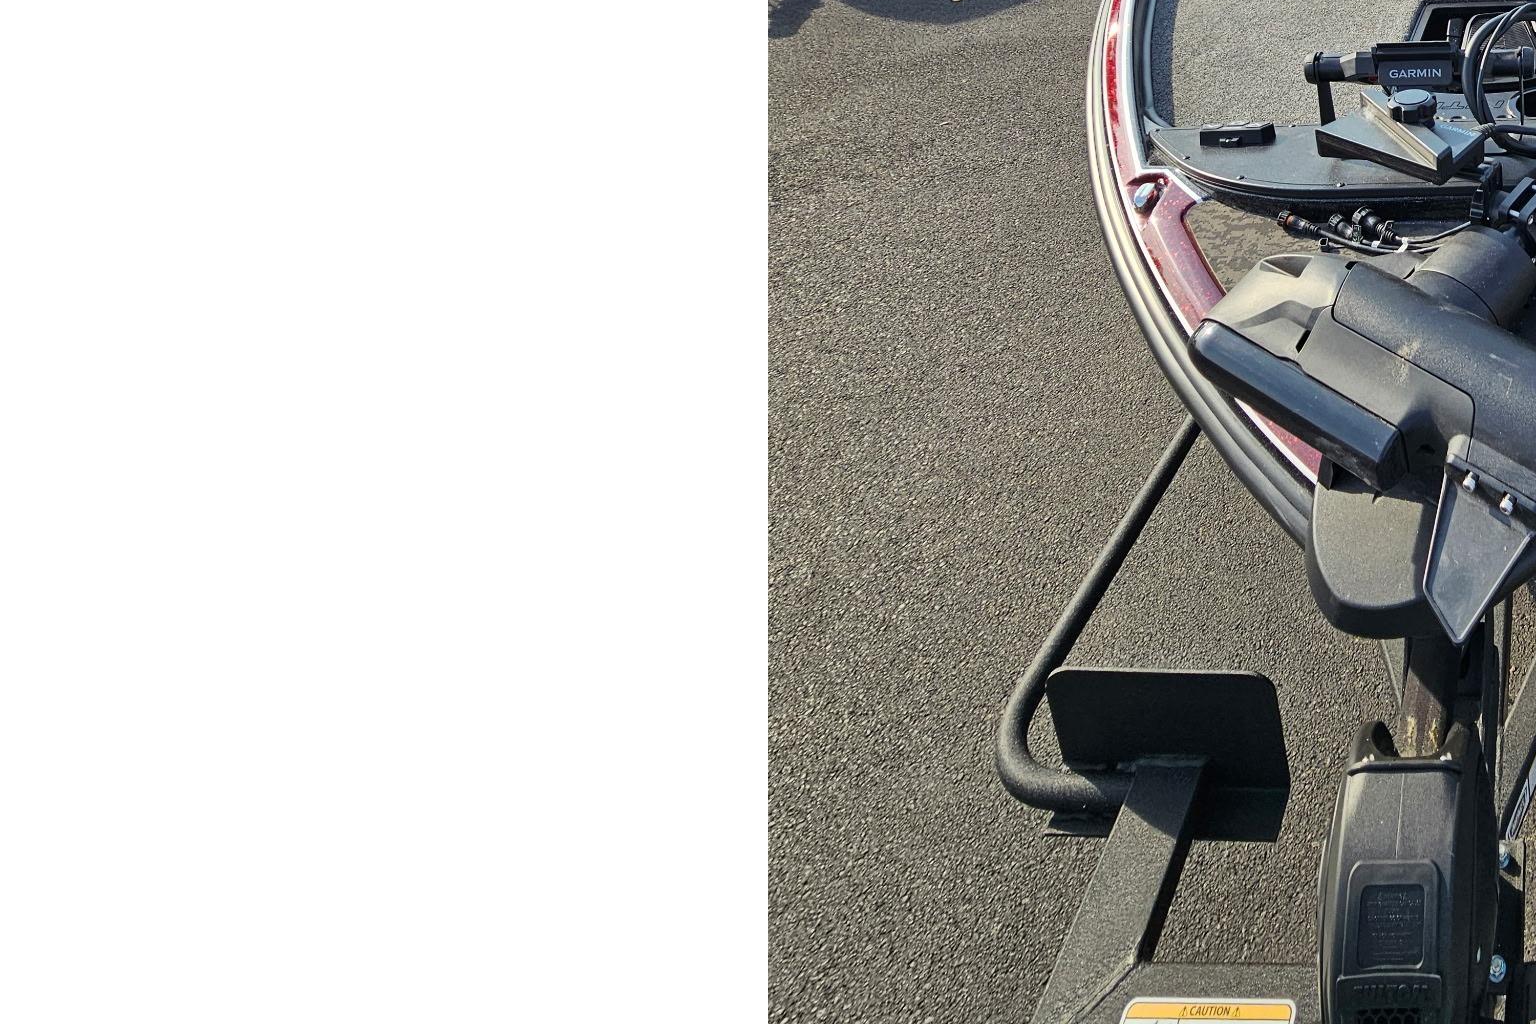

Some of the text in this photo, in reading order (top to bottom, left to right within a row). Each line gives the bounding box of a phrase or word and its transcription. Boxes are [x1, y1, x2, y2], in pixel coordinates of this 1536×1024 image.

[1389, 68, 1442, 78] GARMIN
[1439, 123, 1477, 137] GARMIN
[1189, 1005, 1231, 1017] CAUTION
